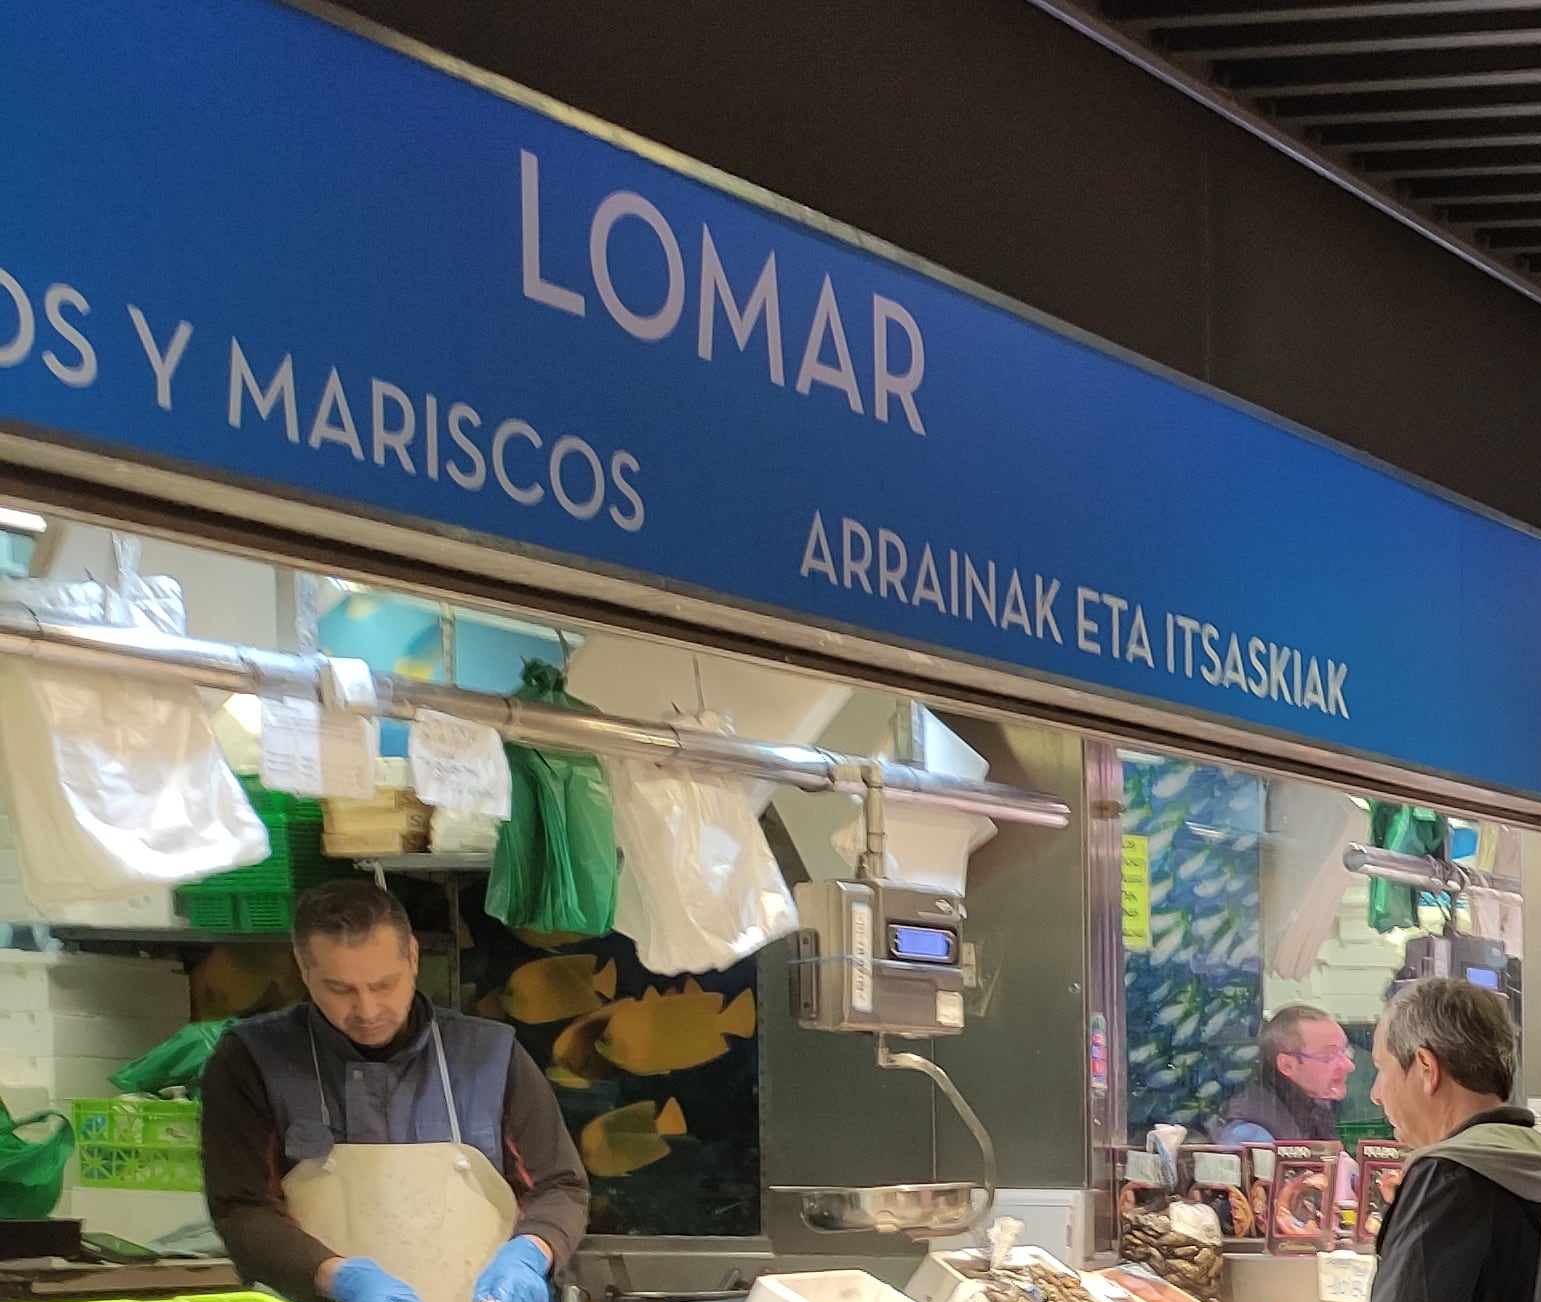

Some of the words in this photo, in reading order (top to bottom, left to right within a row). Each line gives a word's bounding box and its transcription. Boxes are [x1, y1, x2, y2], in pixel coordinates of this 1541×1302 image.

[520, 149, 928, 436] LOMAR
[127, 303, 193, 410] Y
[227, 336, 648, 533] MARISCOS
[800, 509, 1064, 645] ARRAINAK
[1076, 585, 1155, 669] ETA
[1166, 611, 1351, 720] ITSASKIAK
